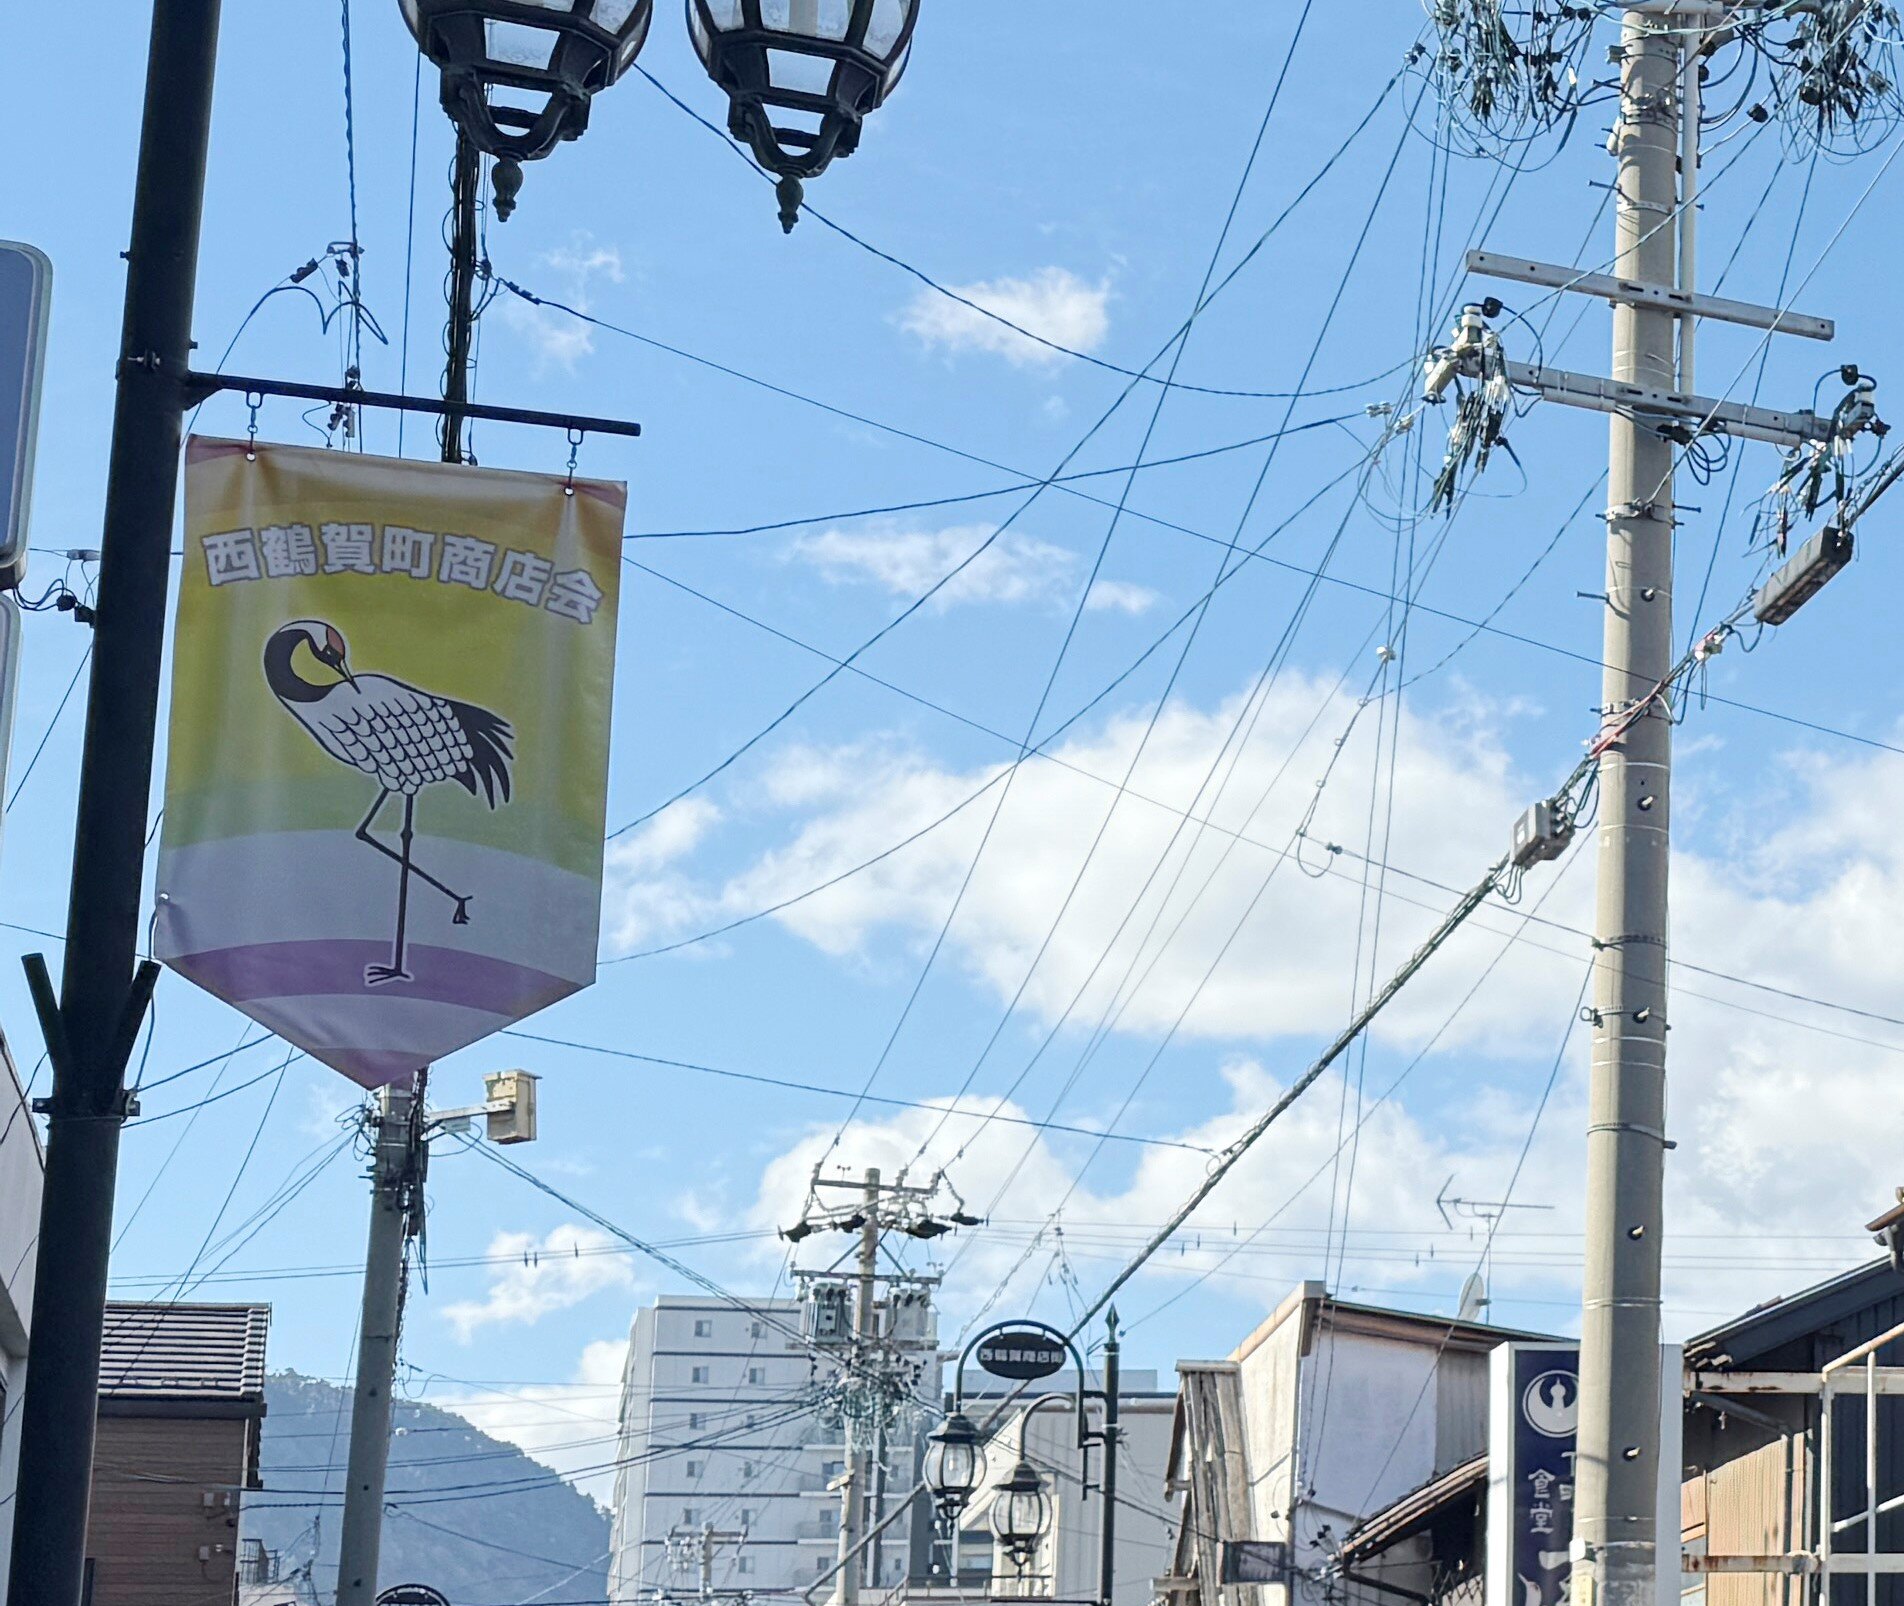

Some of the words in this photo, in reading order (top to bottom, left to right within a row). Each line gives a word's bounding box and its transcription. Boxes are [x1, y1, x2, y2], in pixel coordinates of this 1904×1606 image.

[202, 521, 604, 625] 西鶴賀町商店会
[1528, 1468, 1556, 1534] 食堂
